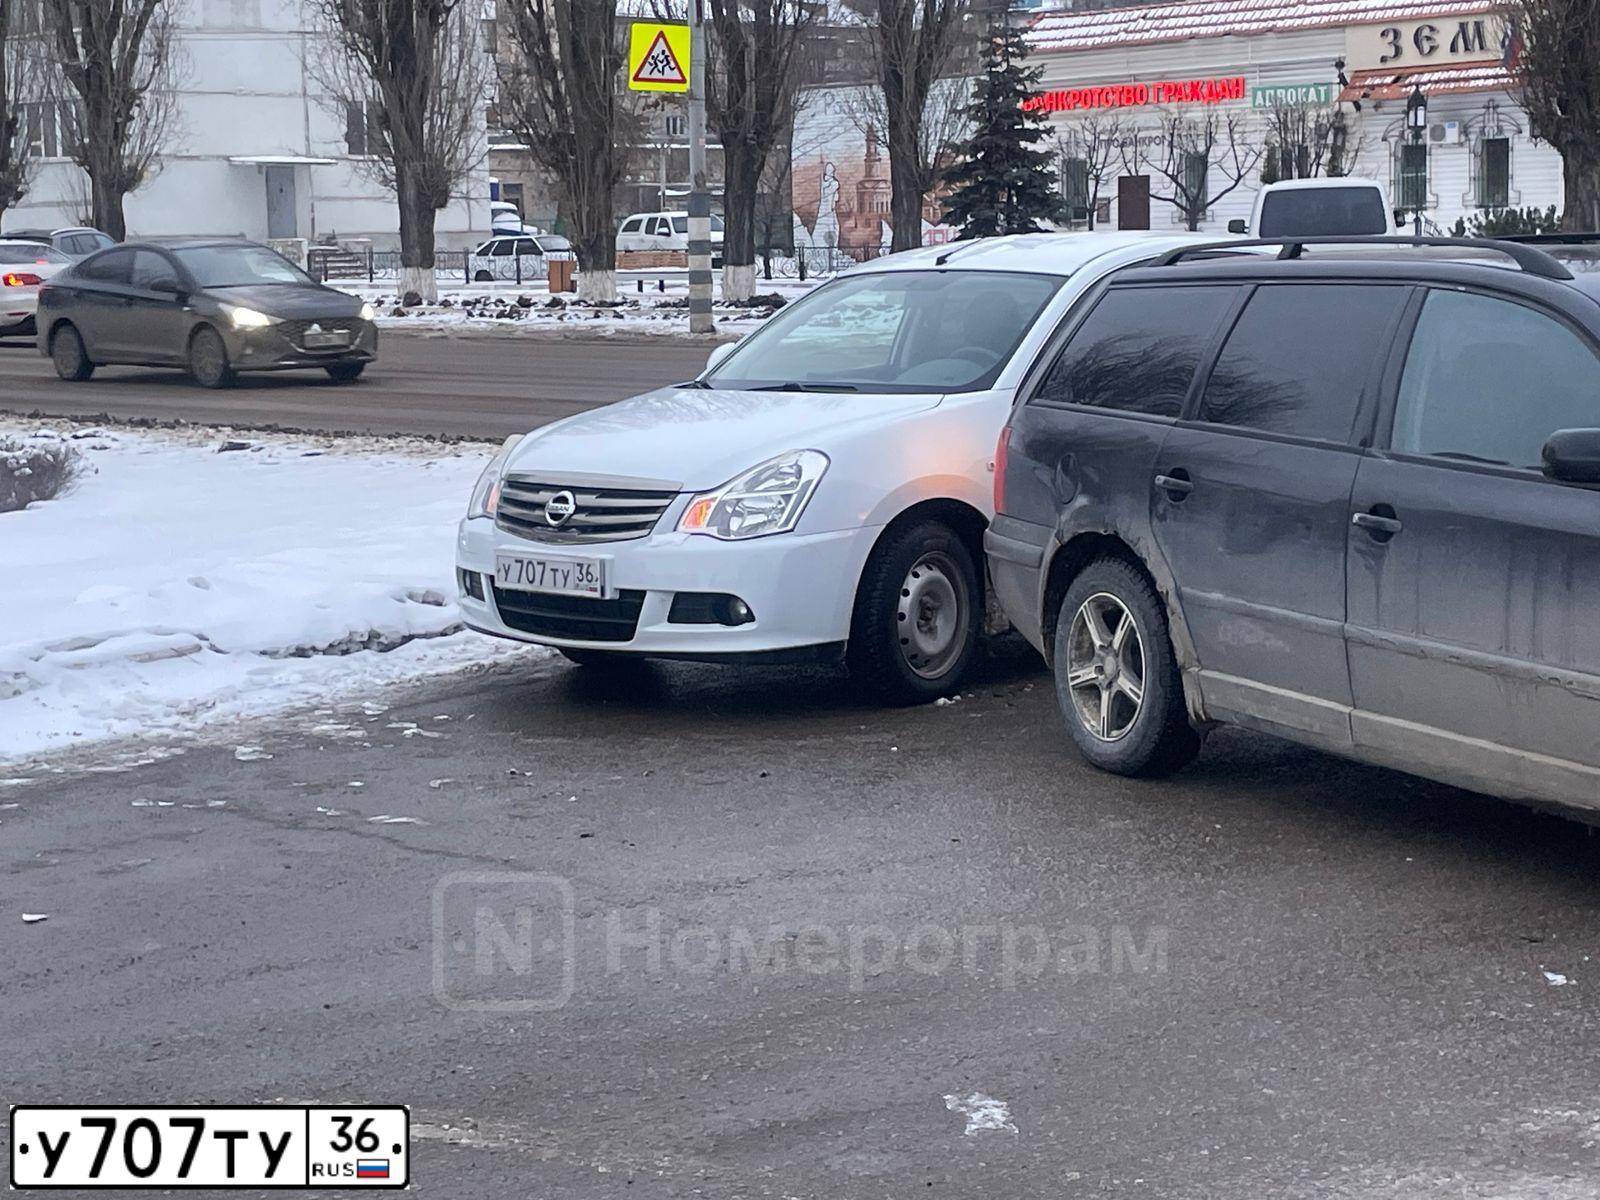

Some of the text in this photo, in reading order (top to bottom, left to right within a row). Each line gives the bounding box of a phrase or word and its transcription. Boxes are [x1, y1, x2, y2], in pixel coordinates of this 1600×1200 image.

[1380, 20, 1507, 64] ЗЕМ
[1153, 77, 1246, 106] ГРАЖДАН
[1255, 86, 1328, 107] АДВОКАТ
[576, 562, 594, 583] 36
